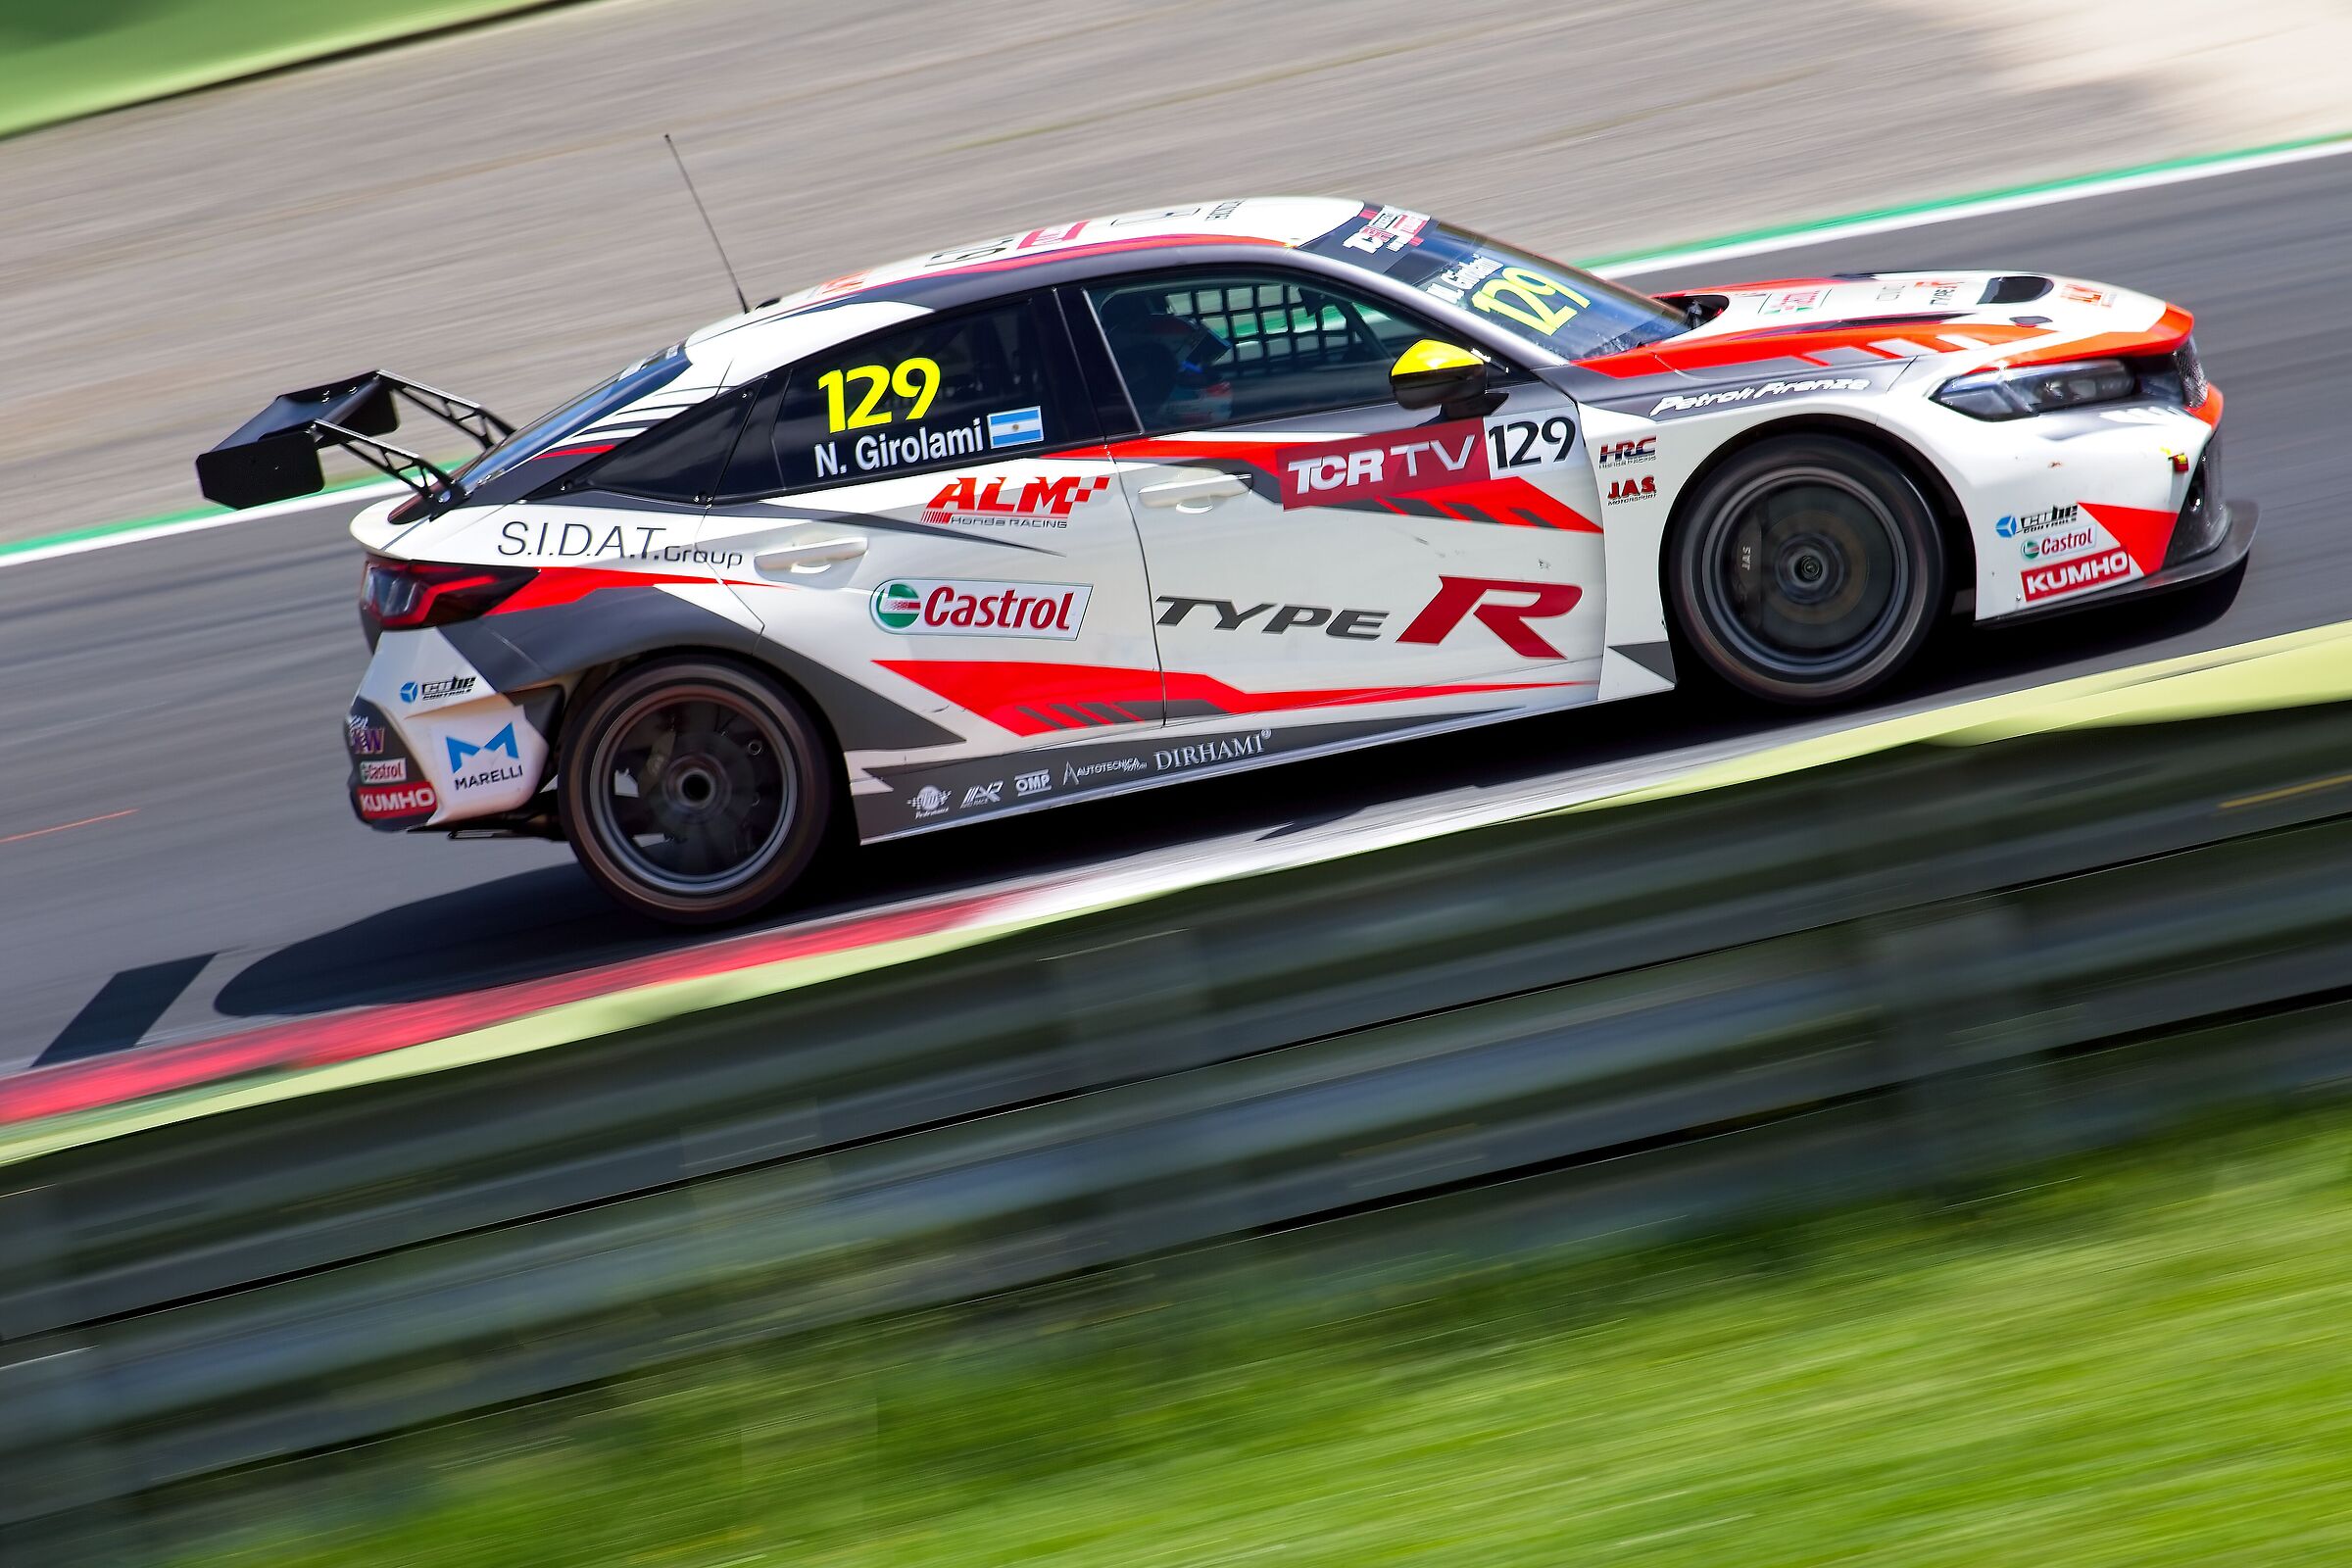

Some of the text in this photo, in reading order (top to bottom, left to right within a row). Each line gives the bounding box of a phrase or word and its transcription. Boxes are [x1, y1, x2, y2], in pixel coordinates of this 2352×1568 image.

[1471, 267, 1592, 337] 129
[817, 357, 941, 434] 129
[1649, 386, 1755, 417] Petroli
[814, 416, 984, 478] N. Girolami
[1488, 416, 1577, 471] 129
[1599, 435, 1657, 463] HRC
[1287, 434, 1476, 495] TCR TV
[926, 476, 1081, 514] ALM
[1608, 475, 1657, 499] JAS
[1009, 519, 1067, 529] RACING
[664, 545, 743, 569] Group
[2040, 528, 2093, 556] Castrol
[2026, 551, 2128, 595] KUMHO
[923, 586, 1074, 631] Castrol
[1155, 573, 1583, 660] TYPE R
[454, 764, 523, 791] MARELLI
[1015, 773, 1051, 792] OMP
[360, 787, 436, 812] KUMHO
